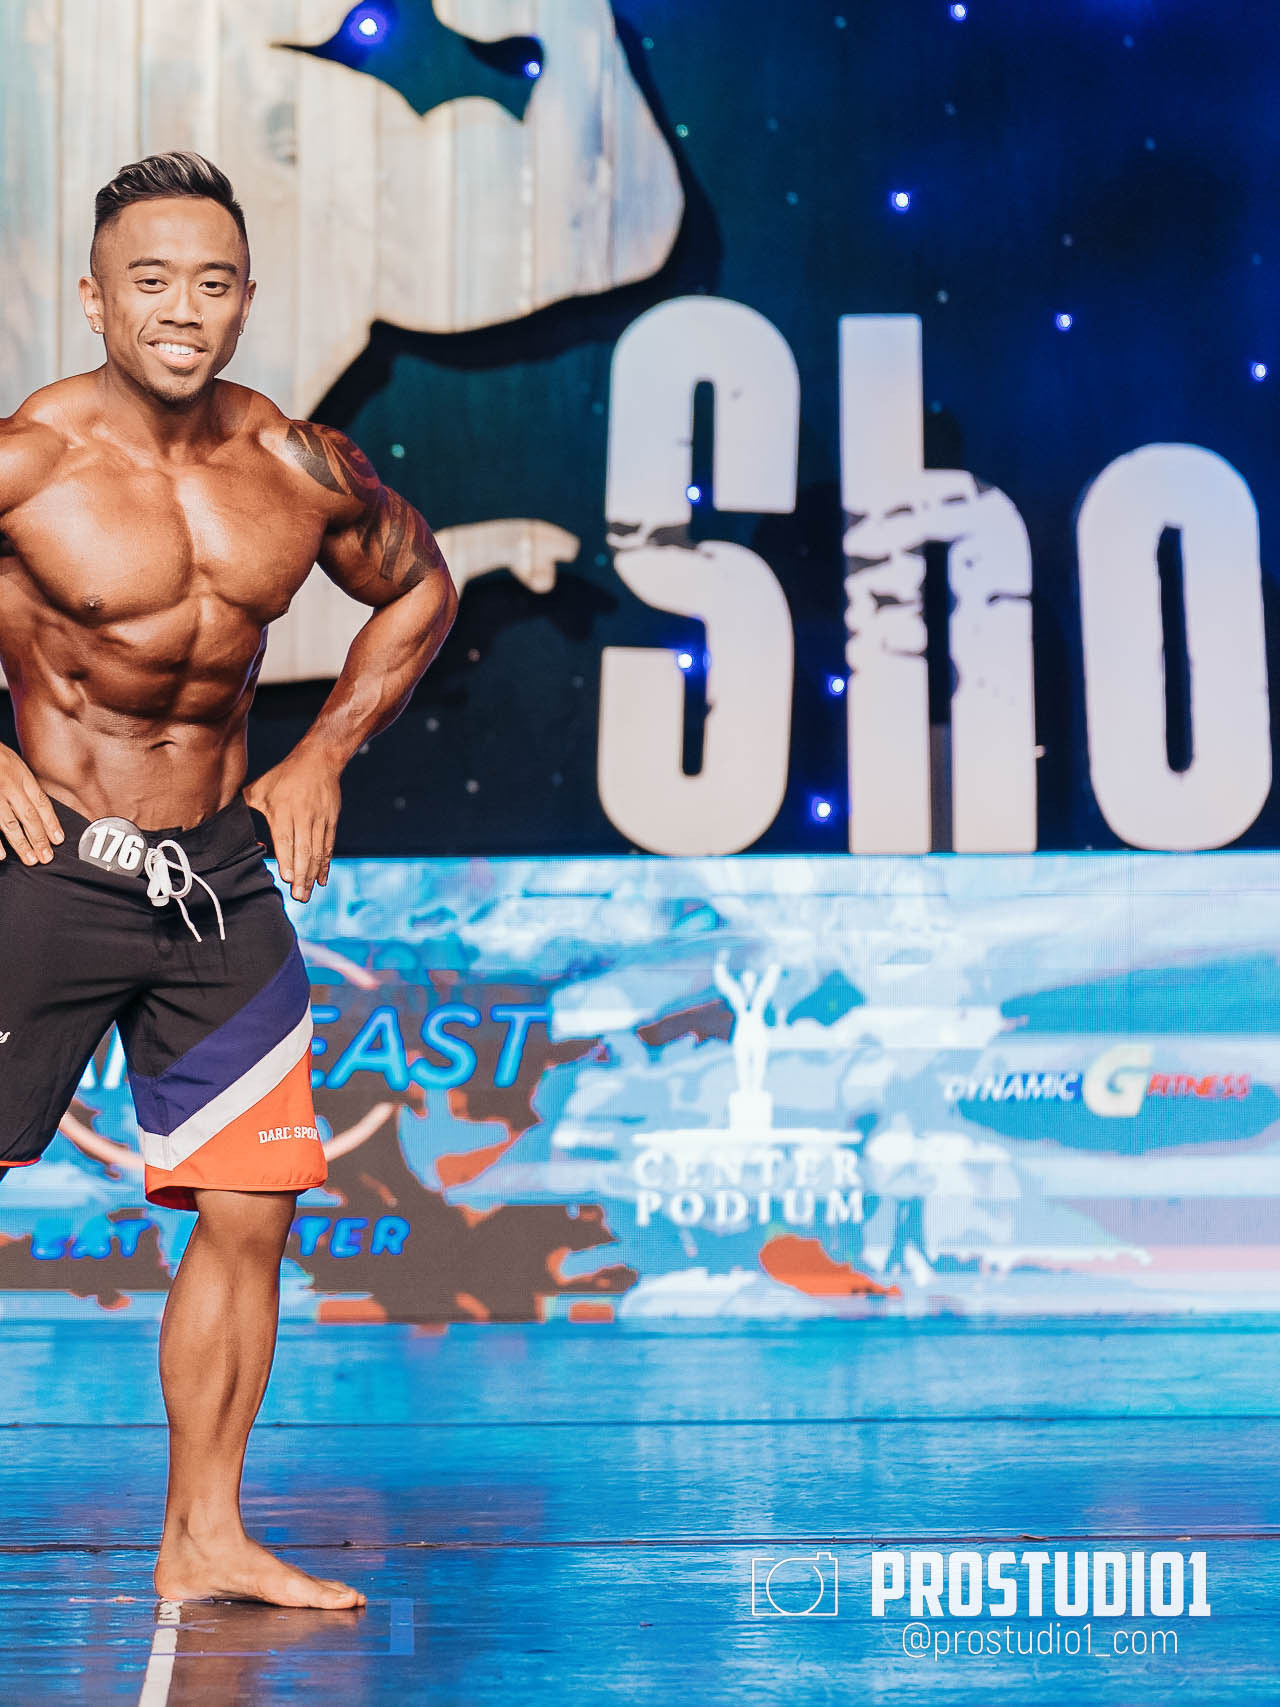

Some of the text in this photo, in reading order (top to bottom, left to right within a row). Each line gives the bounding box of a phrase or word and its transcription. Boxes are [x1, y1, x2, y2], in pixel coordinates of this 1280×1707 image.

[89, 827, 145, 870] 176
[633, 1149, 862, 1187] CENTER
[634, 1189, 865, 1227] PODIUM
